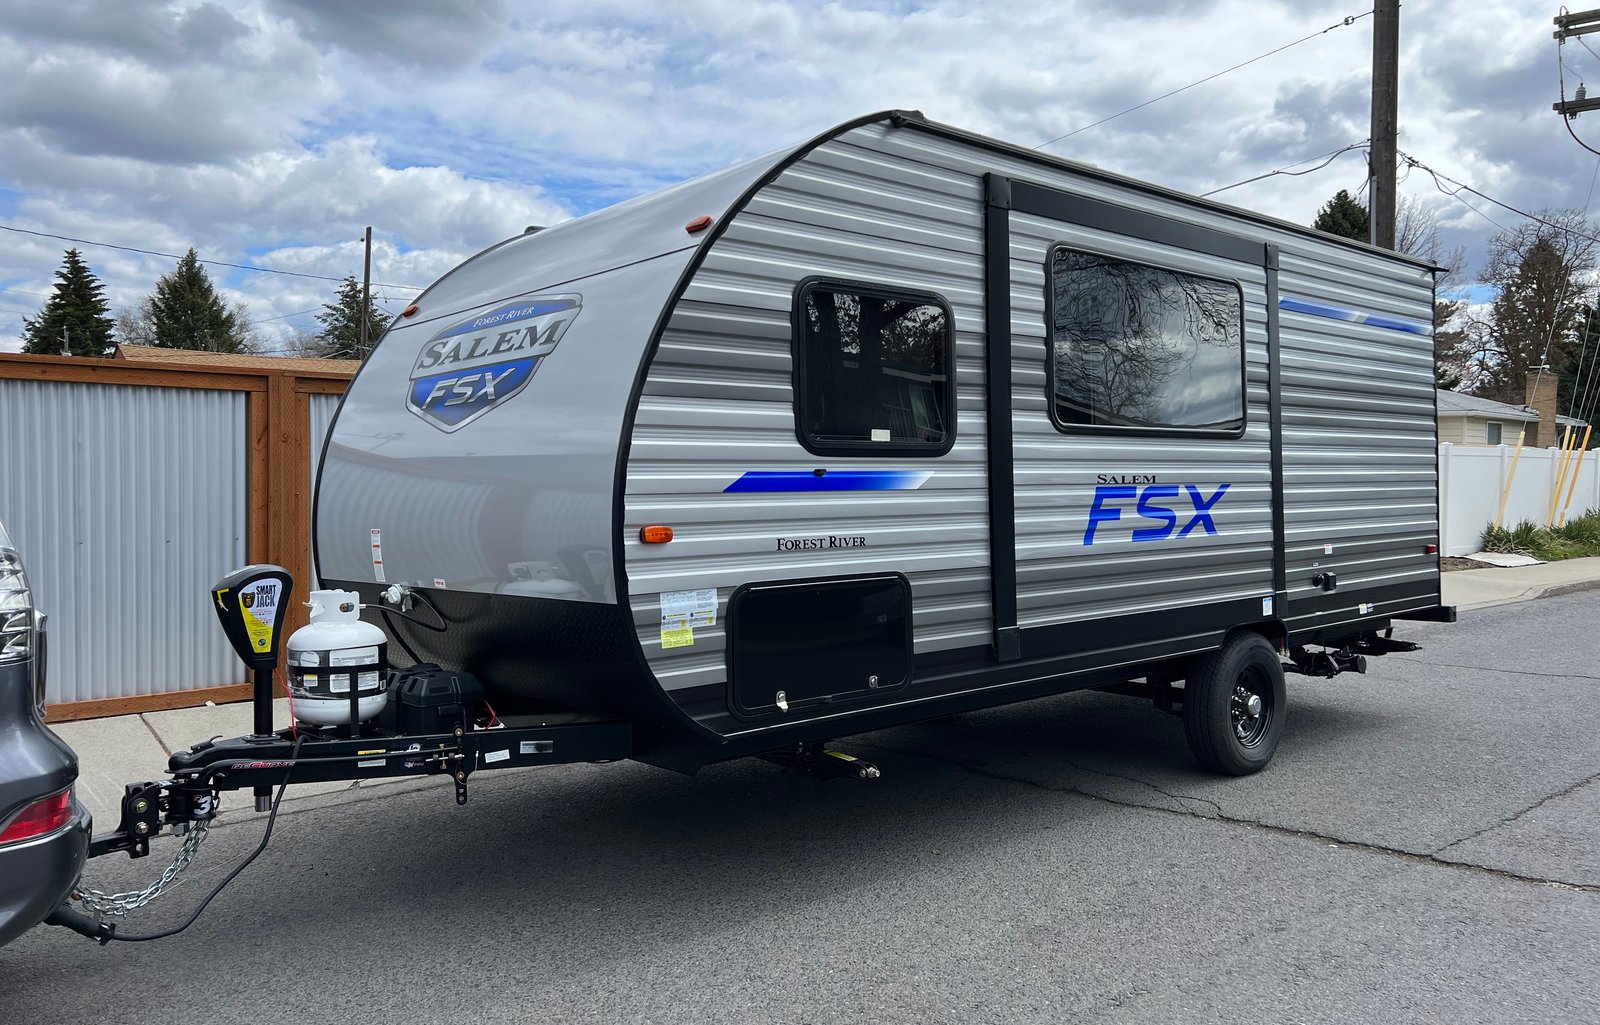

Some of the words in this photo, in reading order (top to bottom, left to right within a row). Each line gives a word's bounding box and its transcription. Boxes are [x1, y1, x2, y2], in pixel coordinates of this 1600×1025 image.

[473, 314, 506, 328] FOREST
[506, 306, 534, 320] RIVER
[417, 318, 567, 370] SALEM
[421, 367, 516, 410] FSX
[1097, 474, 1156, 484] SALEM
[1083, 483, 1231, 545] FSX
[776, 538, 825, 551] FOREST
[828, 535, 866, 548] RIVER
[256, 585, 276, 595] SMART
[256, 595, 275, 608] JACK
